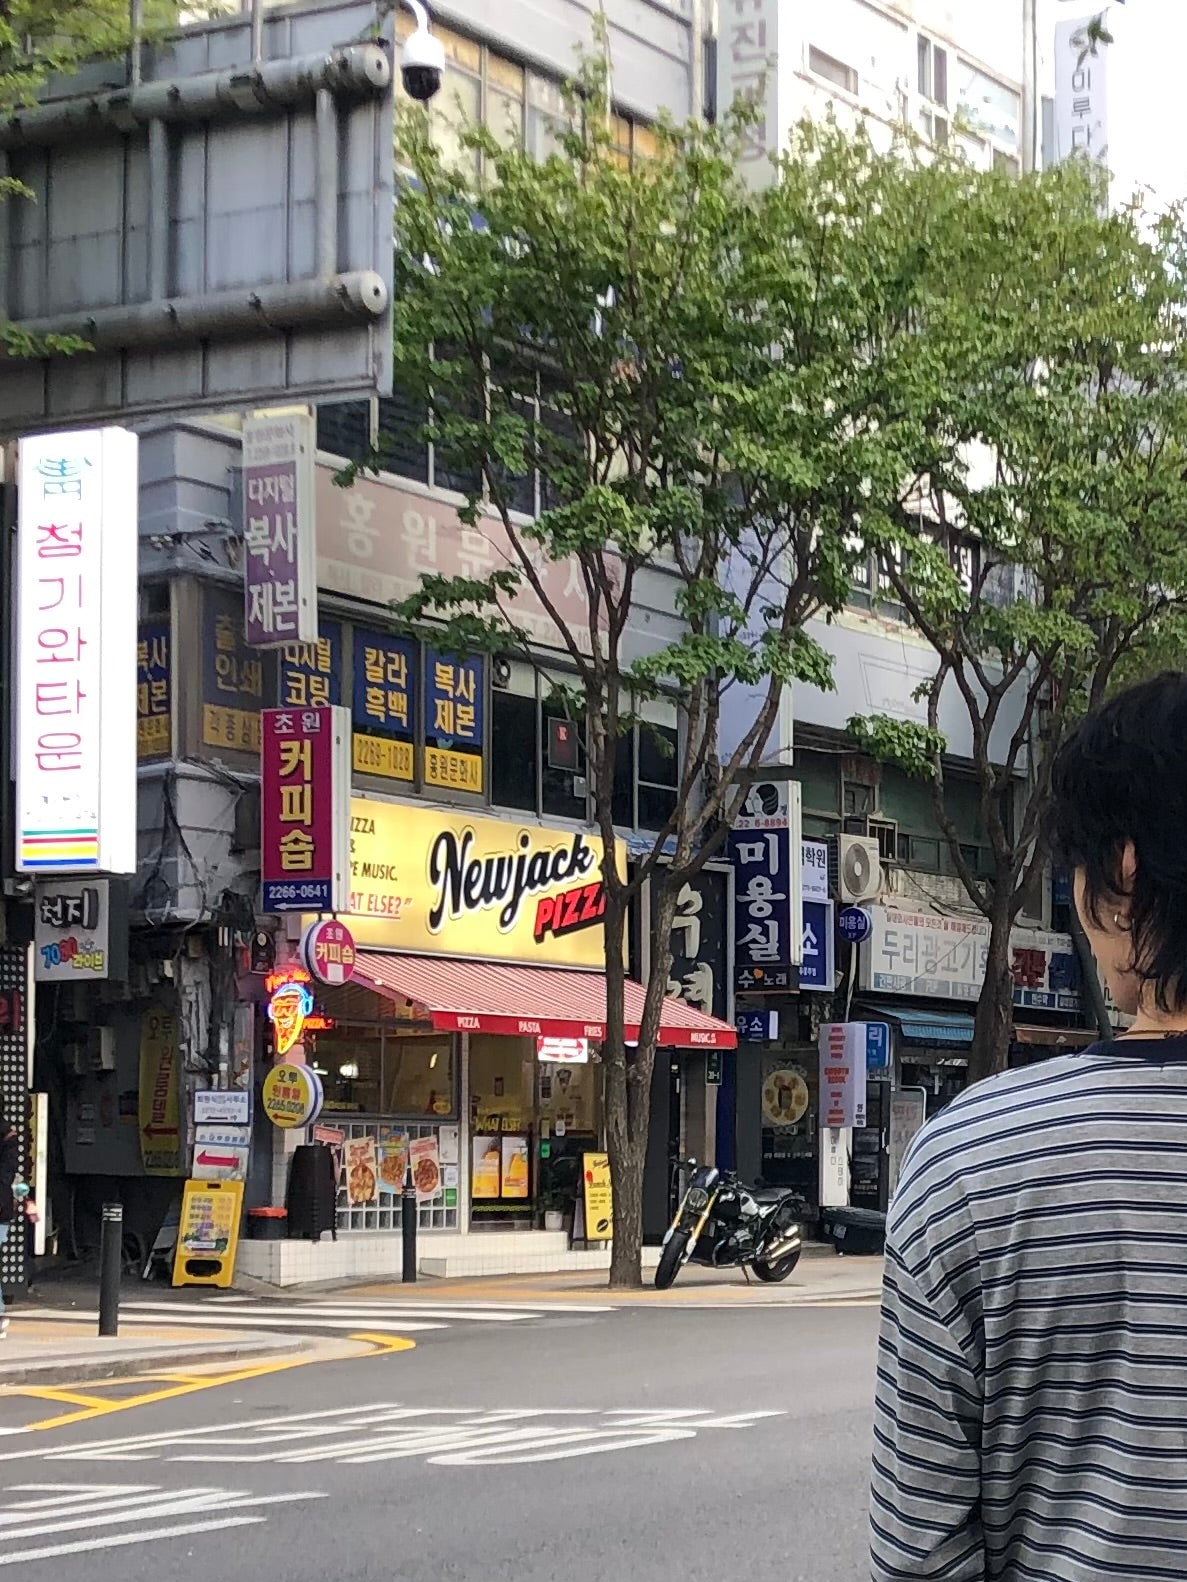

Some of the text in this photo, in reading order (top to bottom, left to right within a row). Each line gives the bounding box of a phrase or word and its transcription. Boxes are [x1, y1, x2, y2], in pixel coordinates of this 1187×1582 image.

[248, 474, 295, 505] 디지털
[248, 511, 298, 566] 복사
[249, 579, 297, 634] 제본
[364, 647, 408, 689] 칼라
[434, 661, 476, 703] 복사
[286, 671, 331, 708] 코팅
[365, 687, 408, 728] 흑백
[274, 712, 322, 734] 초원
[434, 698, 476, 738] 제본
[279, 739, 315, 870] 커피숍
[350, 816, 375, 836] IZZA
[429, 828, 595, 930] Newjack
[735, 832, 788, 963] 미용실
[349, 890, 364, 911] AT
[802, 922, 819, 956] 소
[839, 915, 866, 932] 미용실
[457, 1016, 480, 1030] PIZZA
[518, 1020, 541, 1034] PASTA
